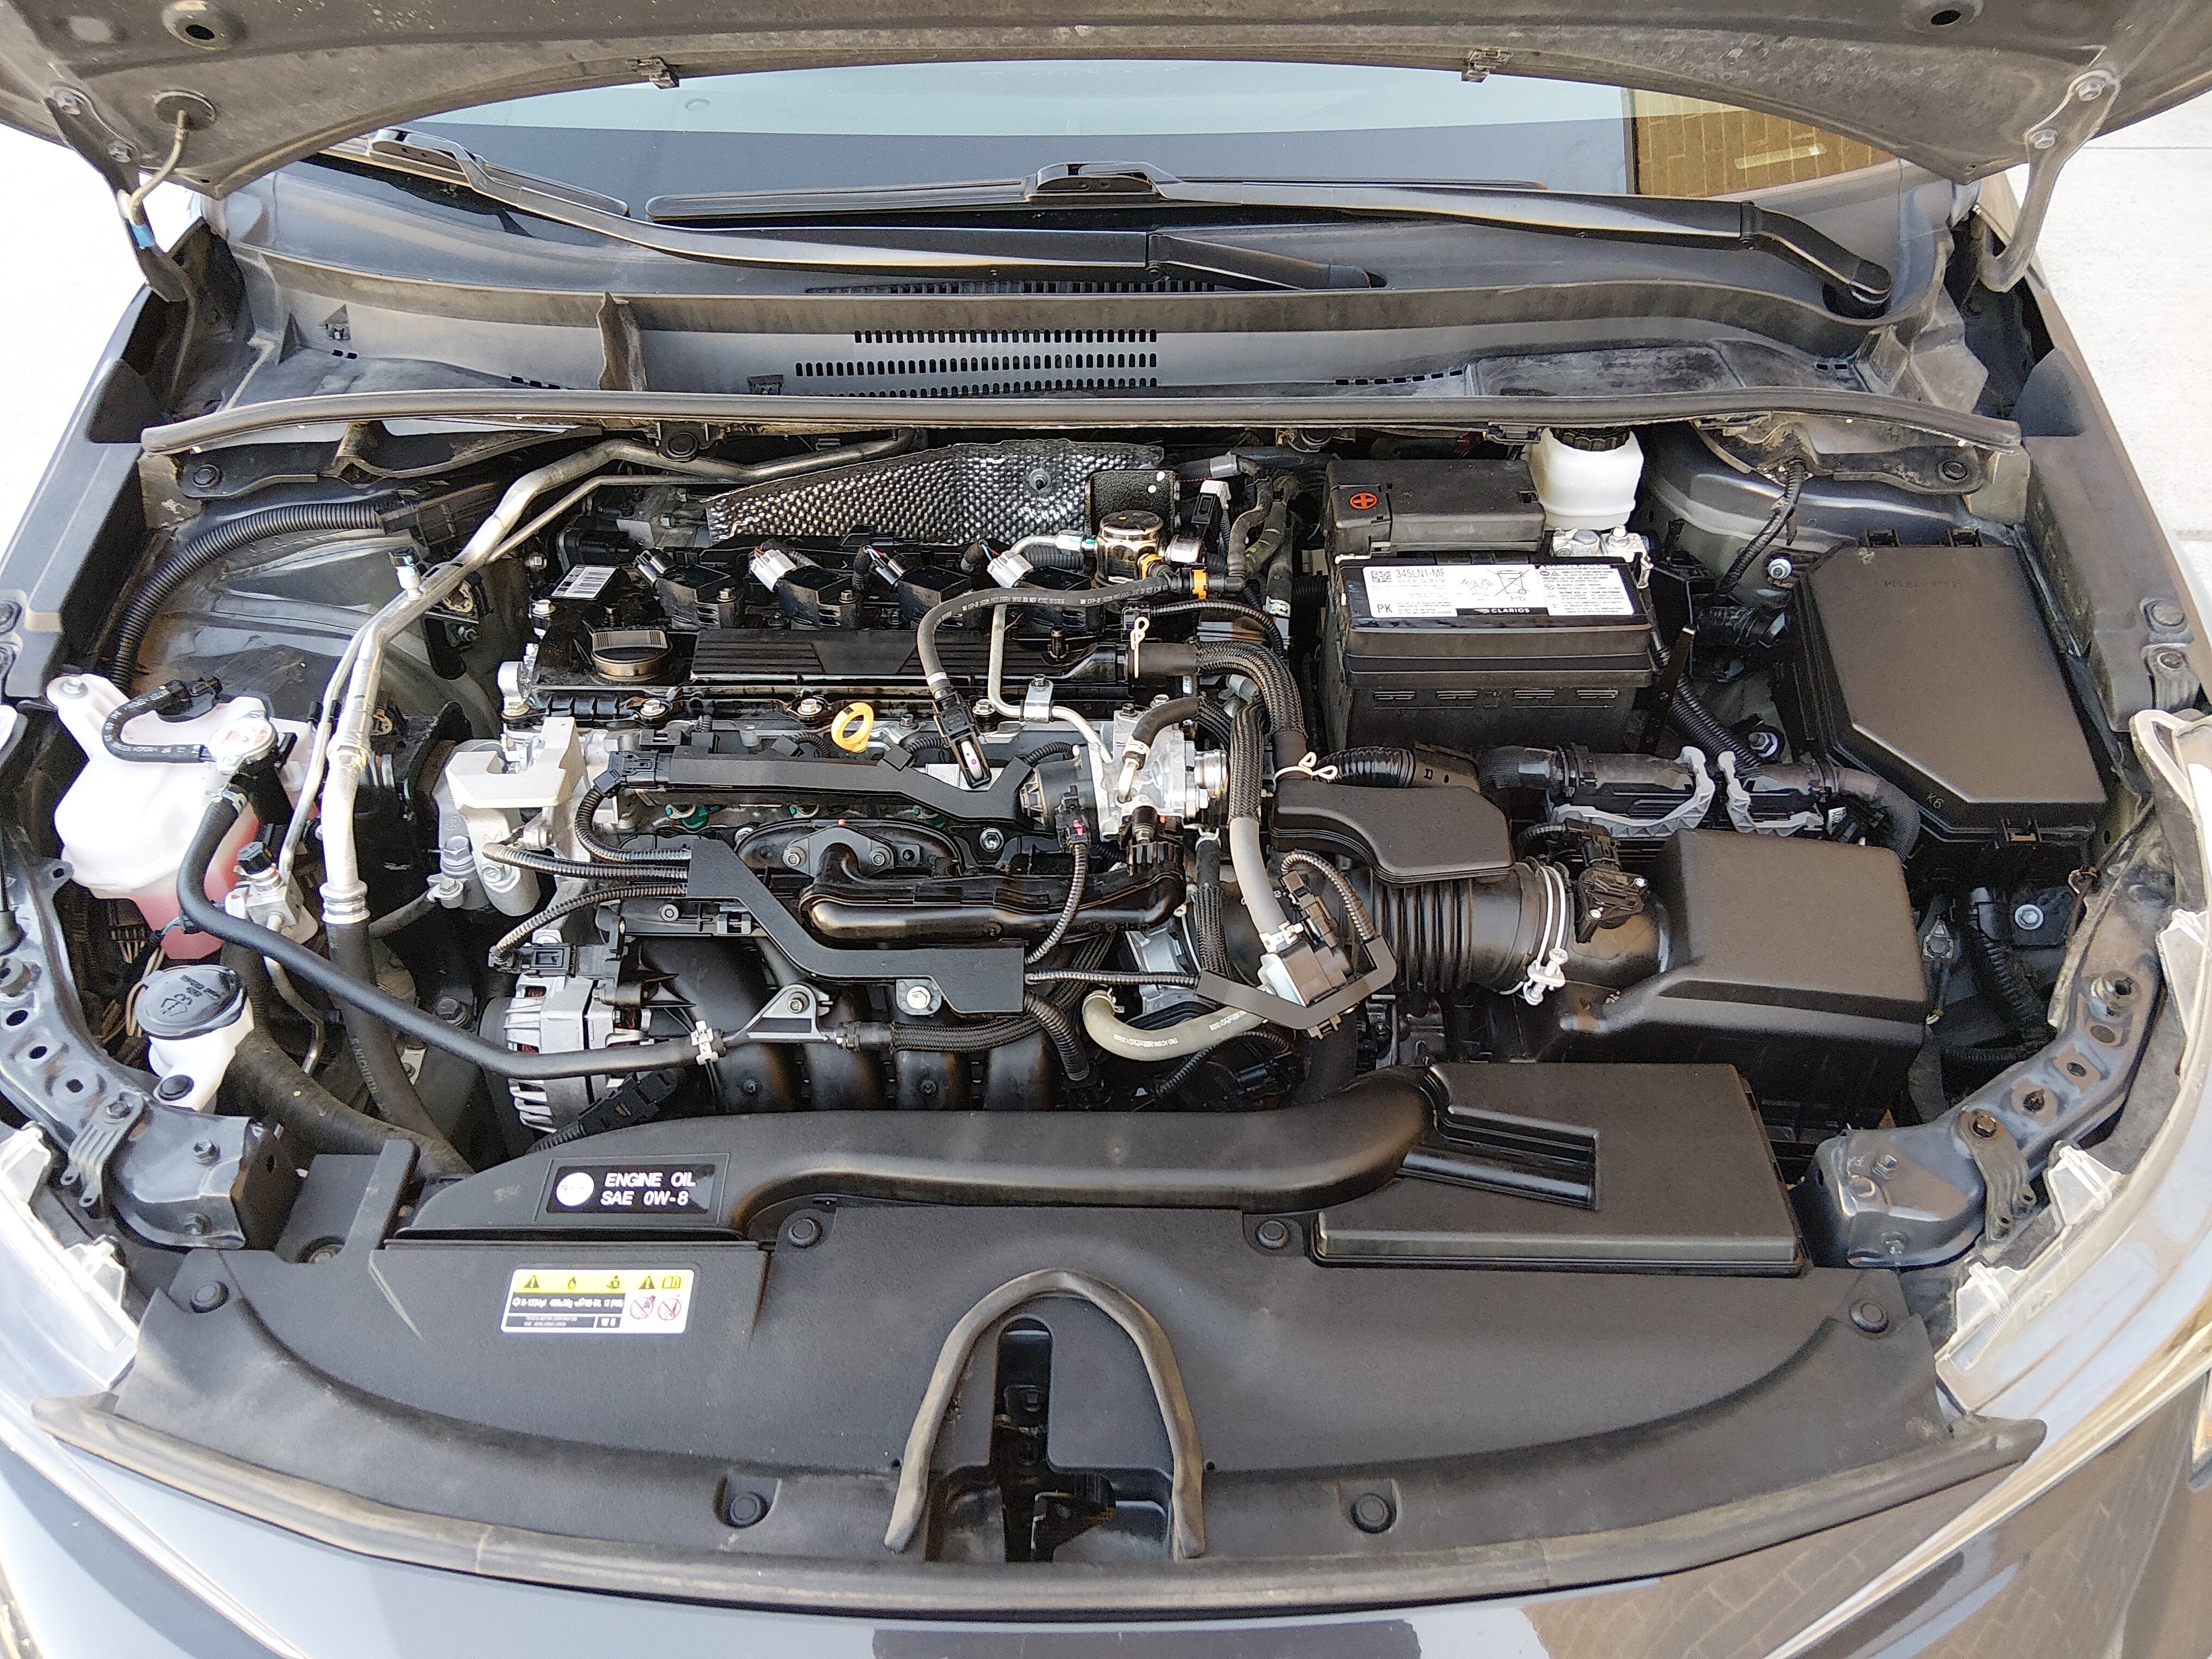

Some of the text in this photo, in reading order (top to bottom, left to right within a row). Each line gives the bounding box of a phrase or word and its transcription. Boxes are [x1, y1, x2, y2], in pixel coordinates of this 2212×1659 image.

[1395, 568, 1445, 578] 345LN1-MF
[1377, 603, 1393, 613] PK
[1926, 793, 1944, 809] K6
[605, 1172, 696, 1187] ENGINE OIL
[600, 1191, 690, 1206] SAE 0W-8
